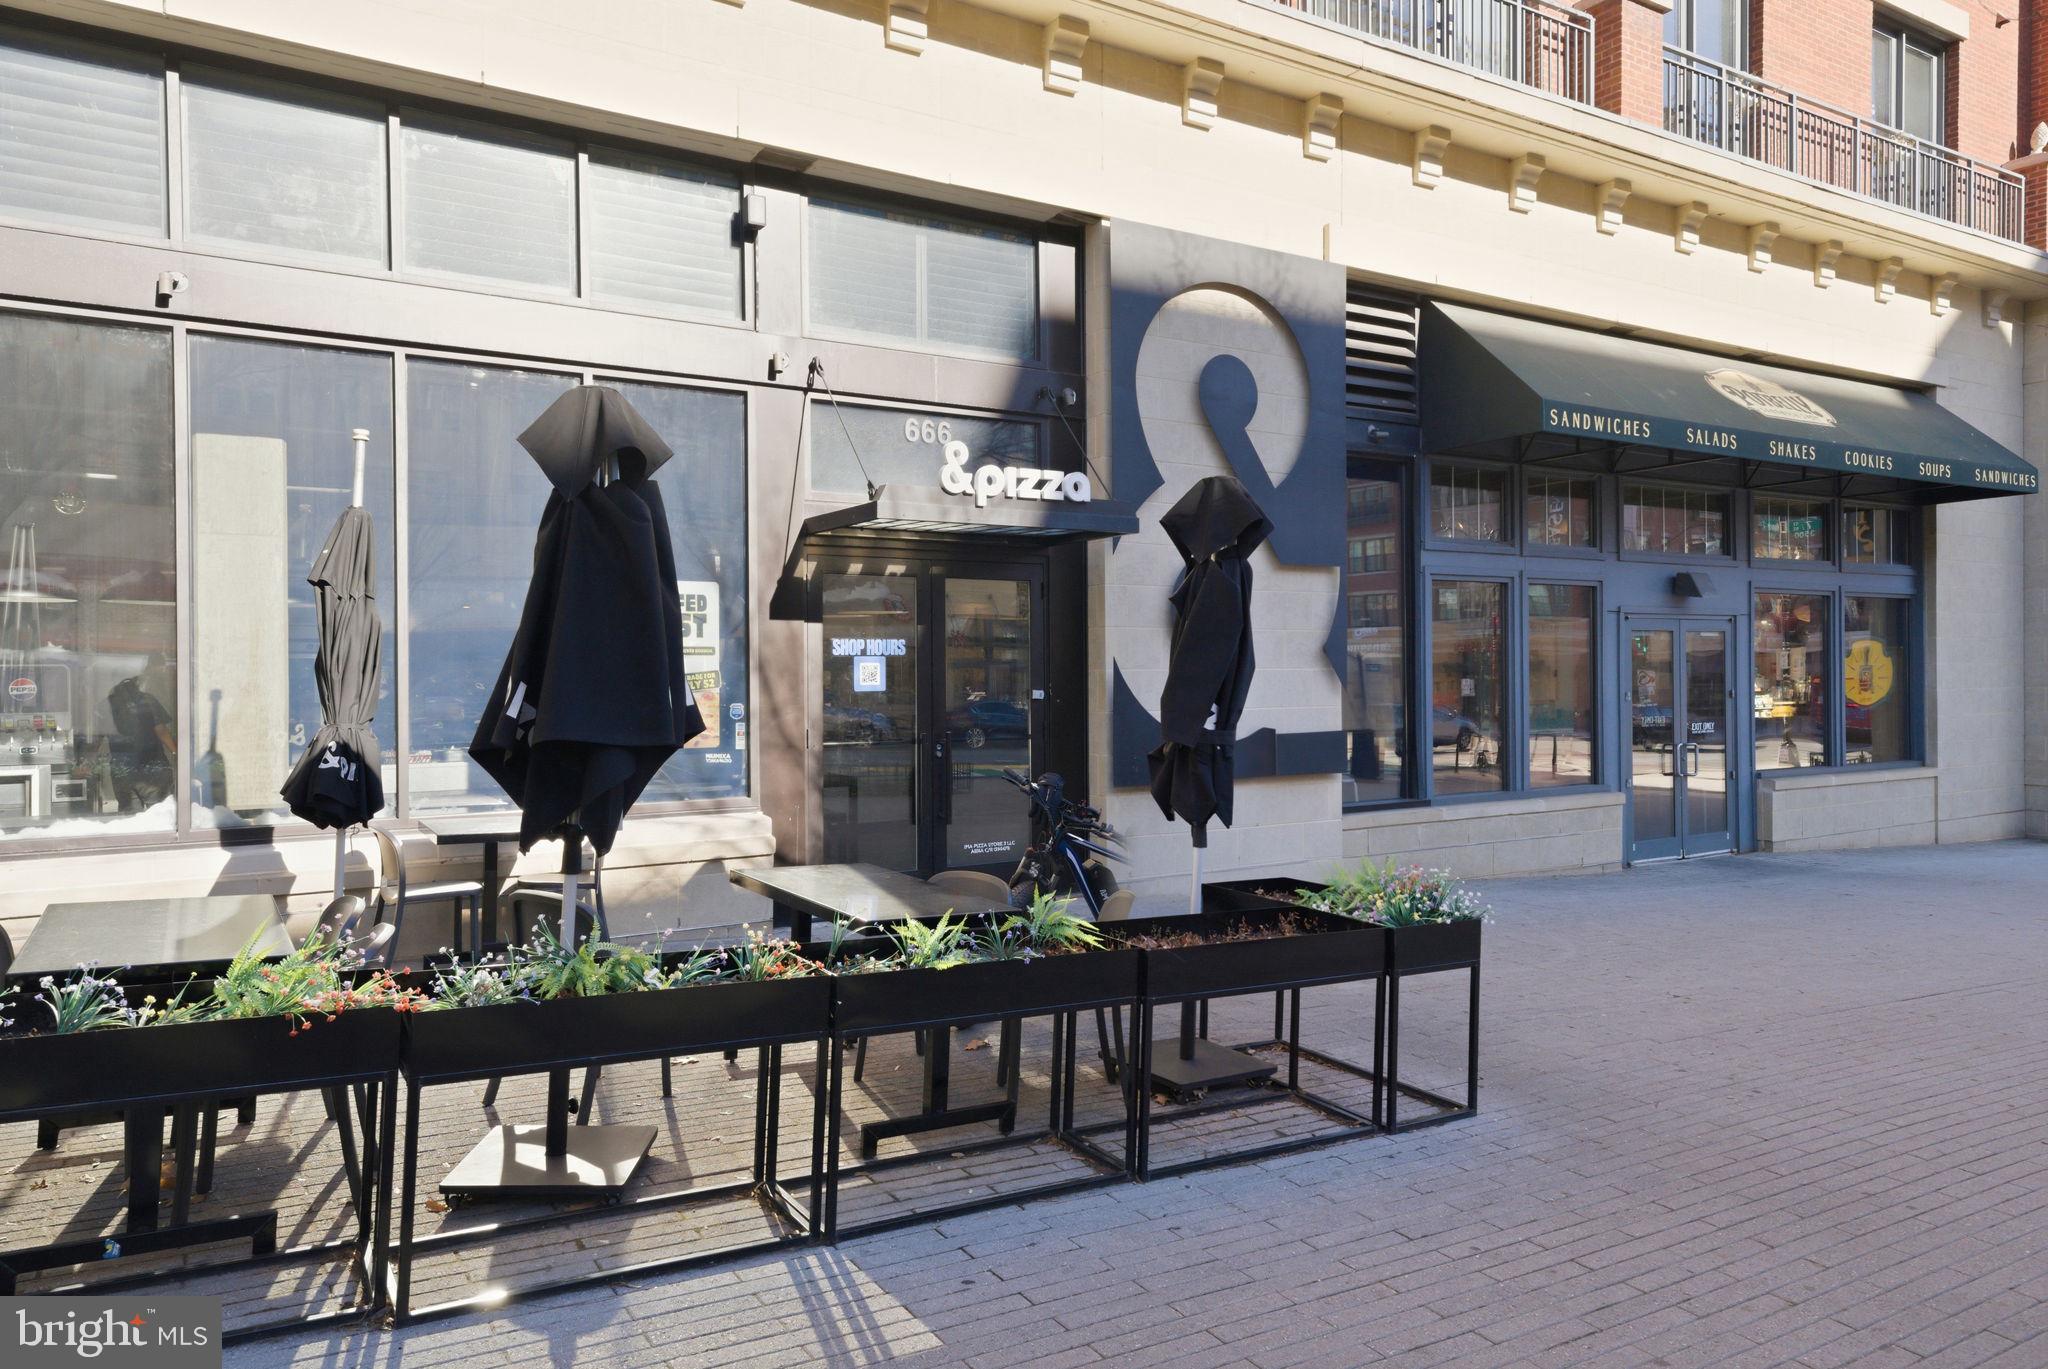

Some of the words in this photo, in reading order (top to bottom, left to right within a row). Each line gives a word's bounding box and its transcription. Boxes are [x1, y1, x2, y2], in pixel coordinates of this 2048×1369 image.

[905, 417, 952, 445] 666
[1550, 409, 1650, 438] SANDWICHES
[1686, 427, 1737, 450] SALADS
[1769, 440, 1816, 461] SHAKES
[1845, 451, 1893, 471] COOKIES
[1919, 462, 1951, 478] SOUPS
[1975, 468, 2036, 488] SANDWICHES
[939, 440, 1091, 509] &pizza
[832, 638, 865, 656] SHOP
[866, 638, 906, 656] HOURS
